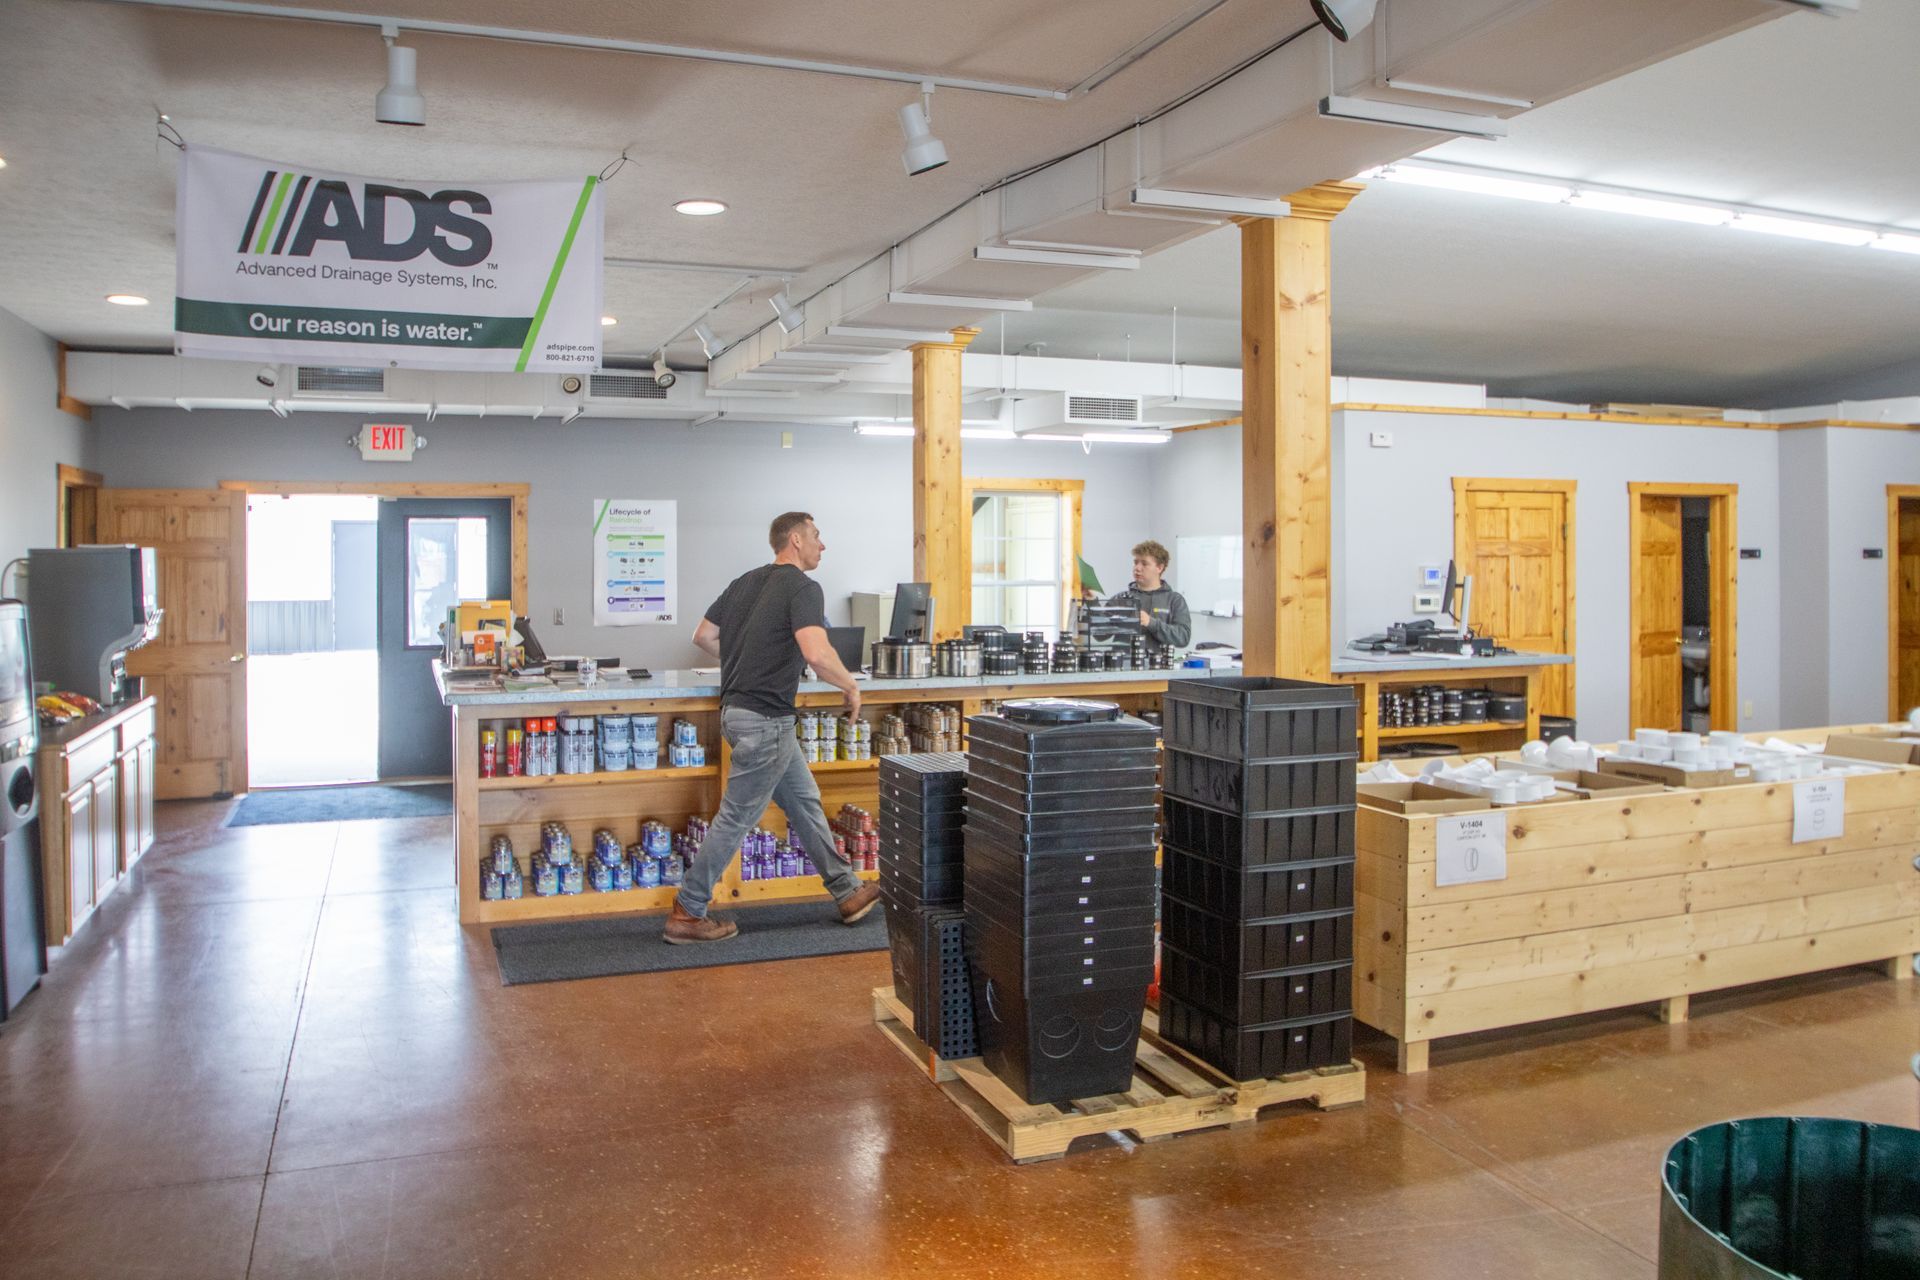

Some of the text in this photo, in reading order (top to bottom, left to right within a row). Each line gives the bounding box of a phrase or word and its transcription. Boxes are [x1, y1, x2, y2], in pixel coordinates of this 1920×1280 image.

[288, 179, 493, 267] ADS
[236, 261, 497, 289] Advanced Drainage Systems, Inc.
[249, 312, 291, 333] Our
[297, 318, 375, 337] reason
[381, 318, 400, 338] is
[546, 343, 595, 352] adspipe.com
[546, 354, 595, 362] 800-821-6710
[371, 426, 406, 451] EXIT
[609, 508, 642, 517] Lifecycle
[1460, 820, 1483, 829] V-1404
